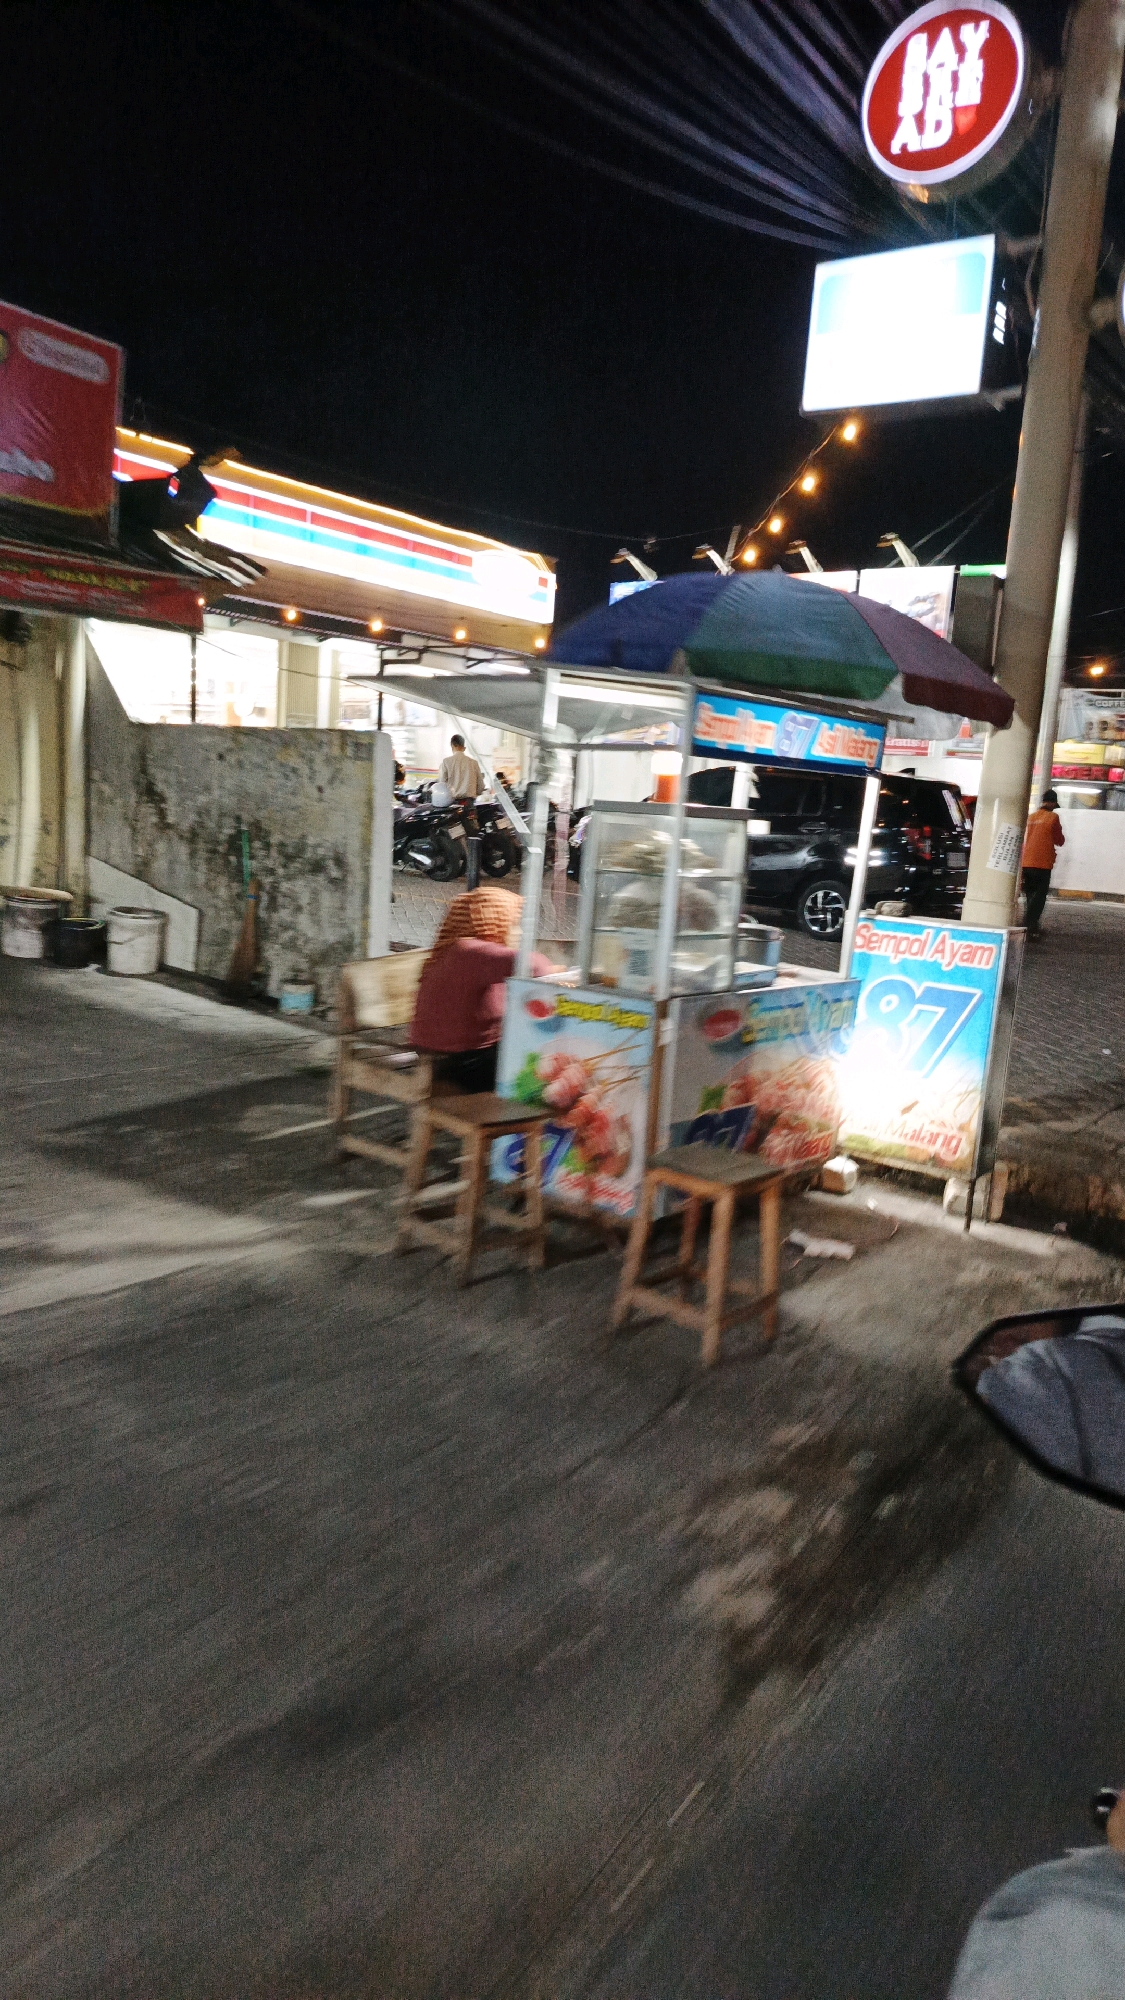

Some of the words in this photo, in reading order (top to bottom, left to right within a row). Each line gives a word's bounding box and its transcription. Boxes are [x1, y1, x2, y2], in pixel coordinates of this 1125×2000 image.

[773, 711, 821, 760] 87
[854, 923, 931, 963] Sempol
[930, 931, 997, 970] Ayam
[862, 975, 985, 1080] 87
